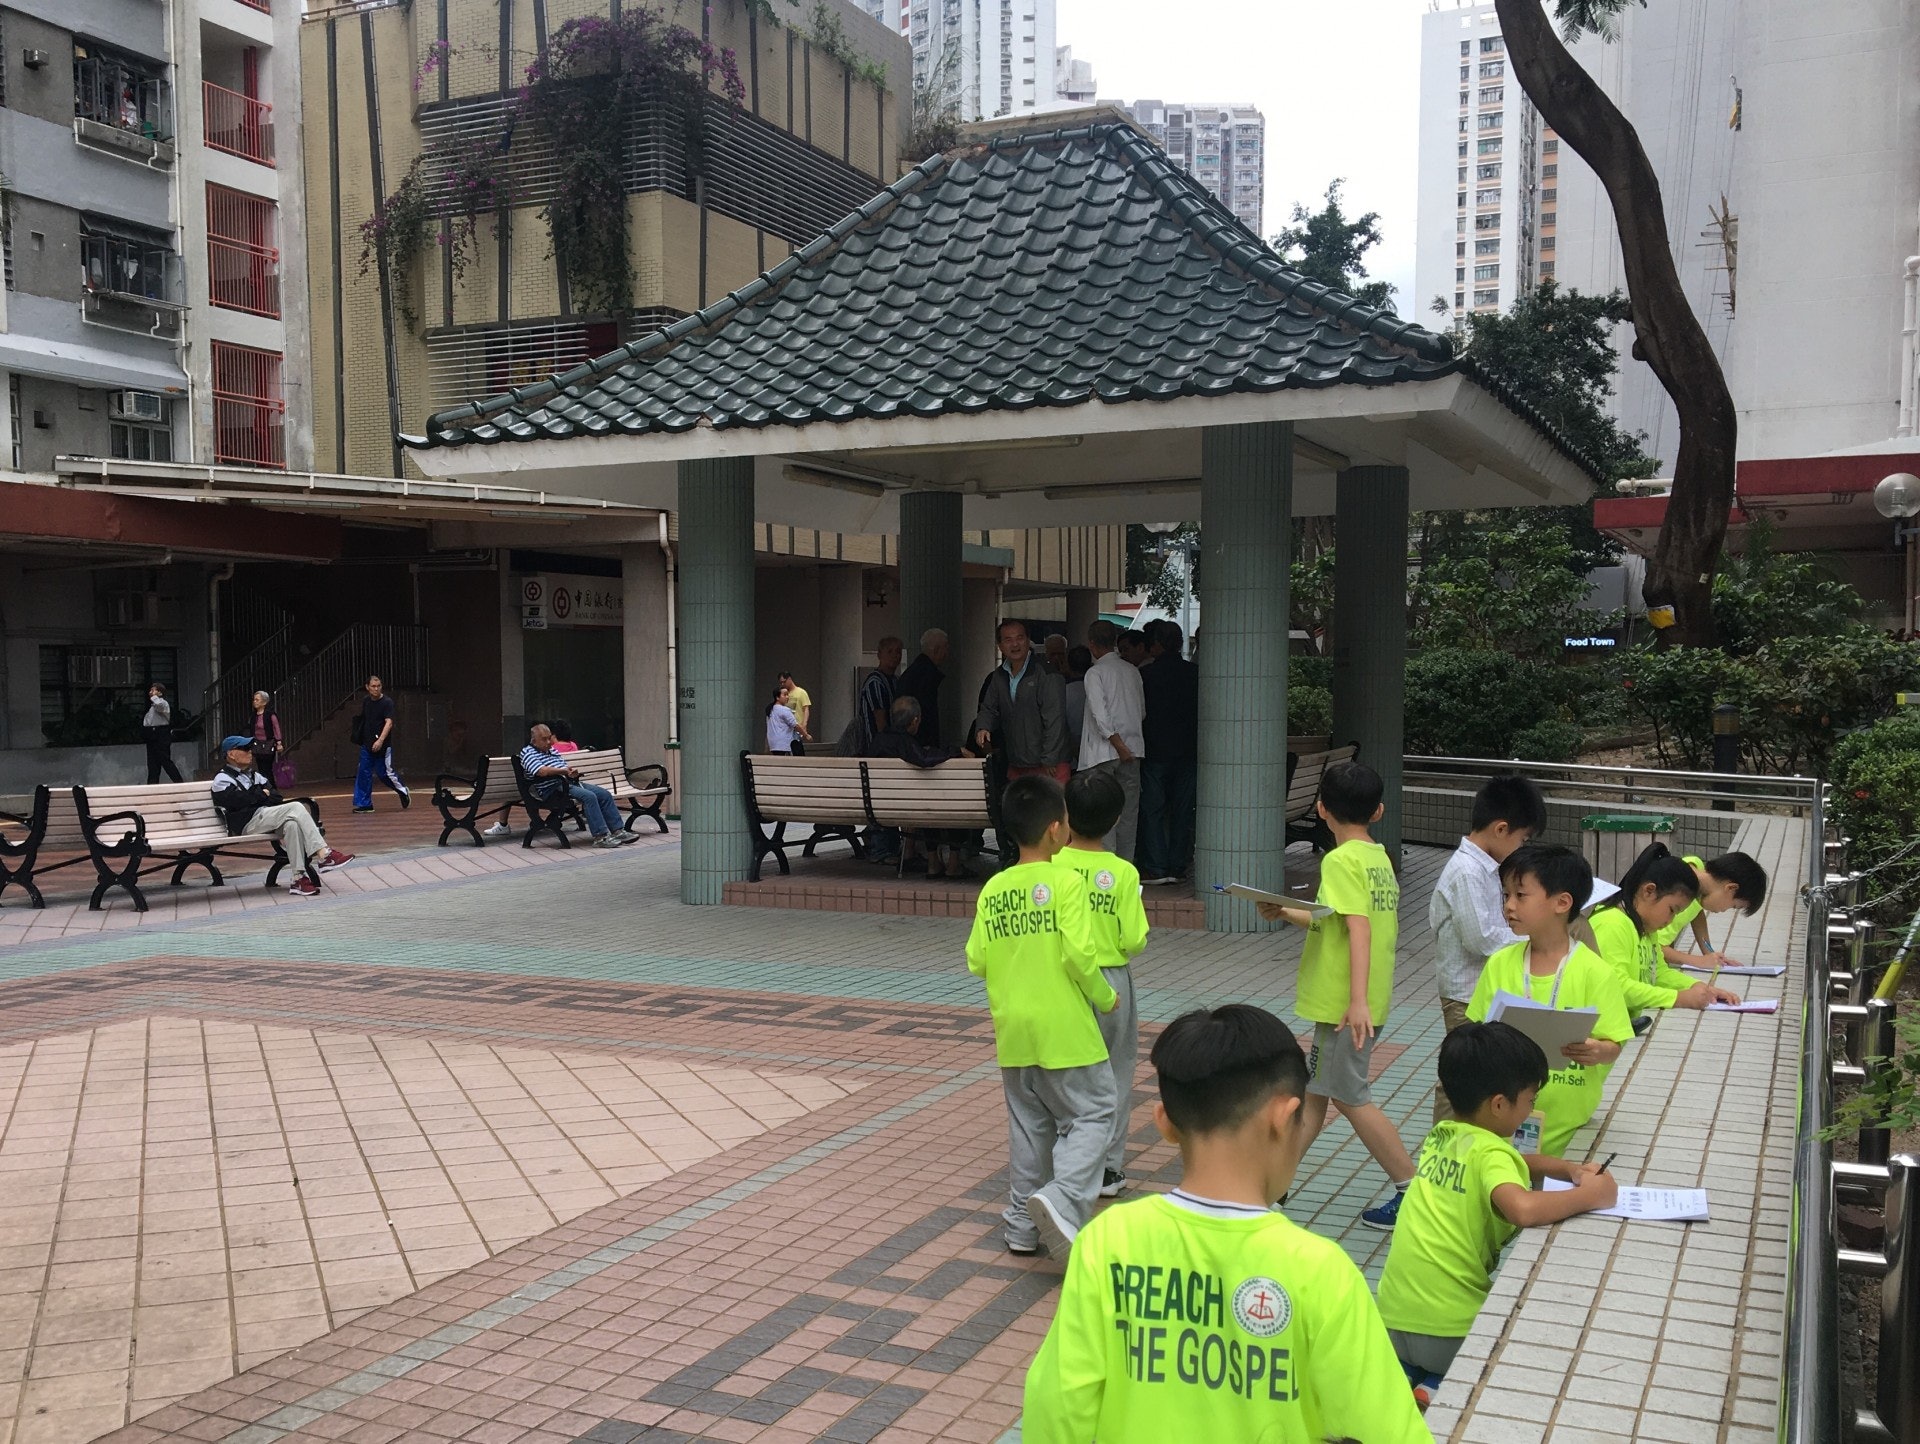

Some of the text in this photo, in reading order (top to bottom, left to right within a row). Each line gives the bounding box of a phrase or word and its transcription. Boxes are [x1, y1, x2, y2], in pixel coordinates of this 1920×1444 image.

[1565, 637, 1615, 646] Food Town
[985, 910, 1058, 942] THE GOSPEL
[1110, 1262, 1224, 1328] PREACH
[1115, 1319, 1299, 1402] THE GOSPEL
